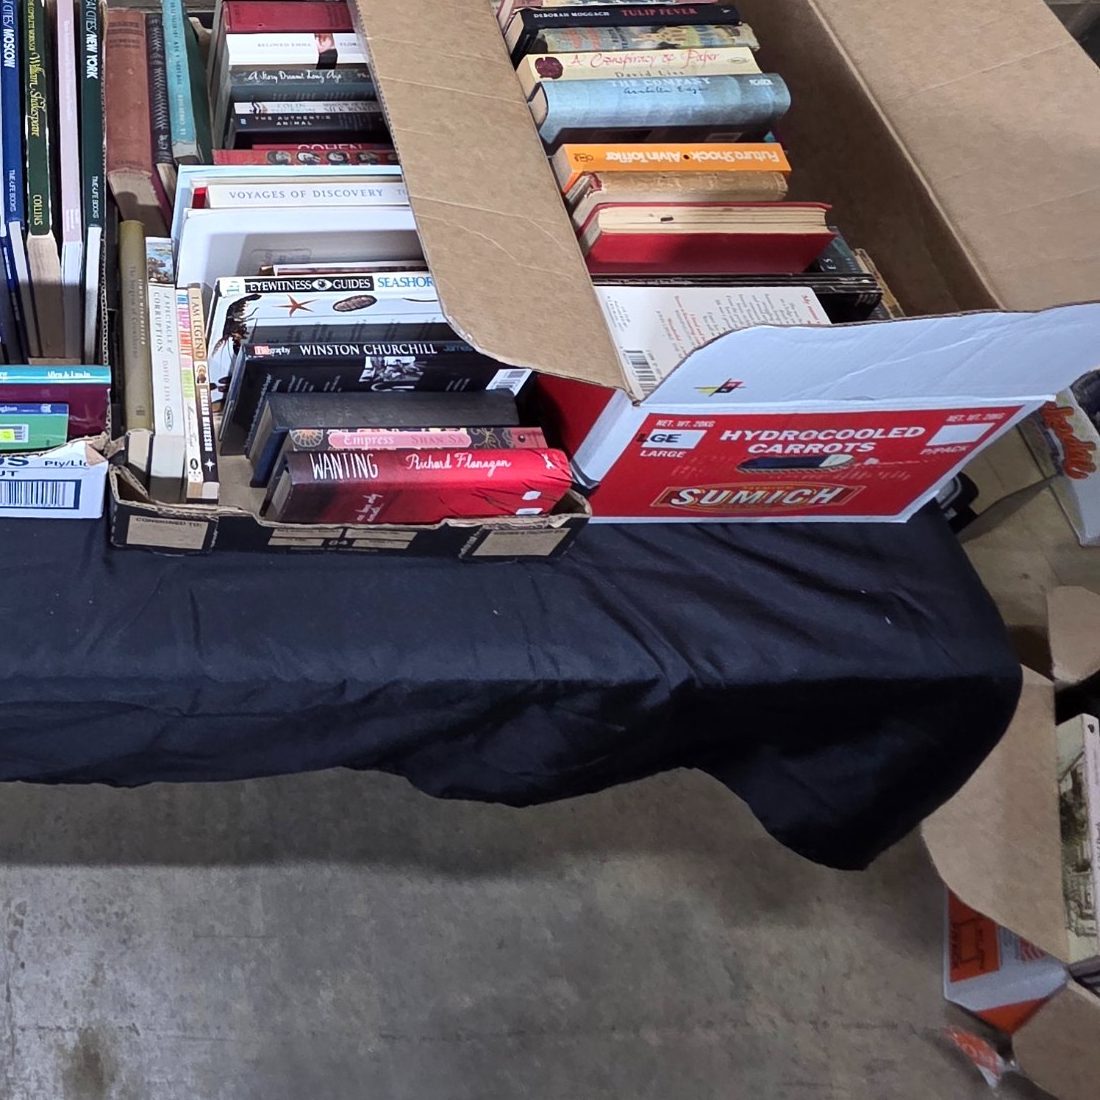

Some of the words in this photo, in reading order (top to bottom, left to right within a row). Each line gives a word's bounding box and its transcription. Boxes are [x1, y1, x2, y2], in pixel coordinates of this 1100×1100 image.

[620, 8, 657, 17] TULIP
[658, 7, 699, 16] FEVER
[569, 54, 582, 66] A
[590, 53, 656, 70] Conspiracy
[681, 48, 721, 69] Paper
[86, 53, 99, 80] YORK
[609, 78, 642, 88] THE
[643, 77, 712, 87] COMPANY
[605, 151, 649, 164] Toffler
[649, 151, 681, 163] Alvin
[691, 151, 737, 163] Shock
[738, 150, 780, 162] Future
[228, 190, 285, 199] VOYAGES
[290, 189, 307, 198] OF
[312, 188, 383, 198] DISCOVERY
[33, 194, 43, 226] COLLINS
[250, 280, 312, 292] EYEWITNESS
[332, 278, 371, 290] GUIDES
[377, 276, 434, 288] SEASHOR
[191, 301, 200, 317] AM
[153, 291, 164, 353] CORRUPTION
[192, 319, 204, 359] LEGEND
[299, 344, 360, 356] WINSTON
[363, 343, 438, 355] CHURCHILL
[343, 433, 395, 447] Empress
[410, 434, 446, 445] SHAN
[448, 435, 464, 445] SA
[636, 433, 682, 444] LGE
[719, 426, 926, 441] HYDROCOOLED
[639, 449, 687, 458] LARGE
[747, 442, 877, 455] CARROTS
[309, 452, 379, 481] WANTING
[405, 453, 452, 471] Richard
[452, 453, 512, 477] Flanagan
[670, 486, 845, 506] SUMICH
[135, 516, 187, 526] CONSIGNED
